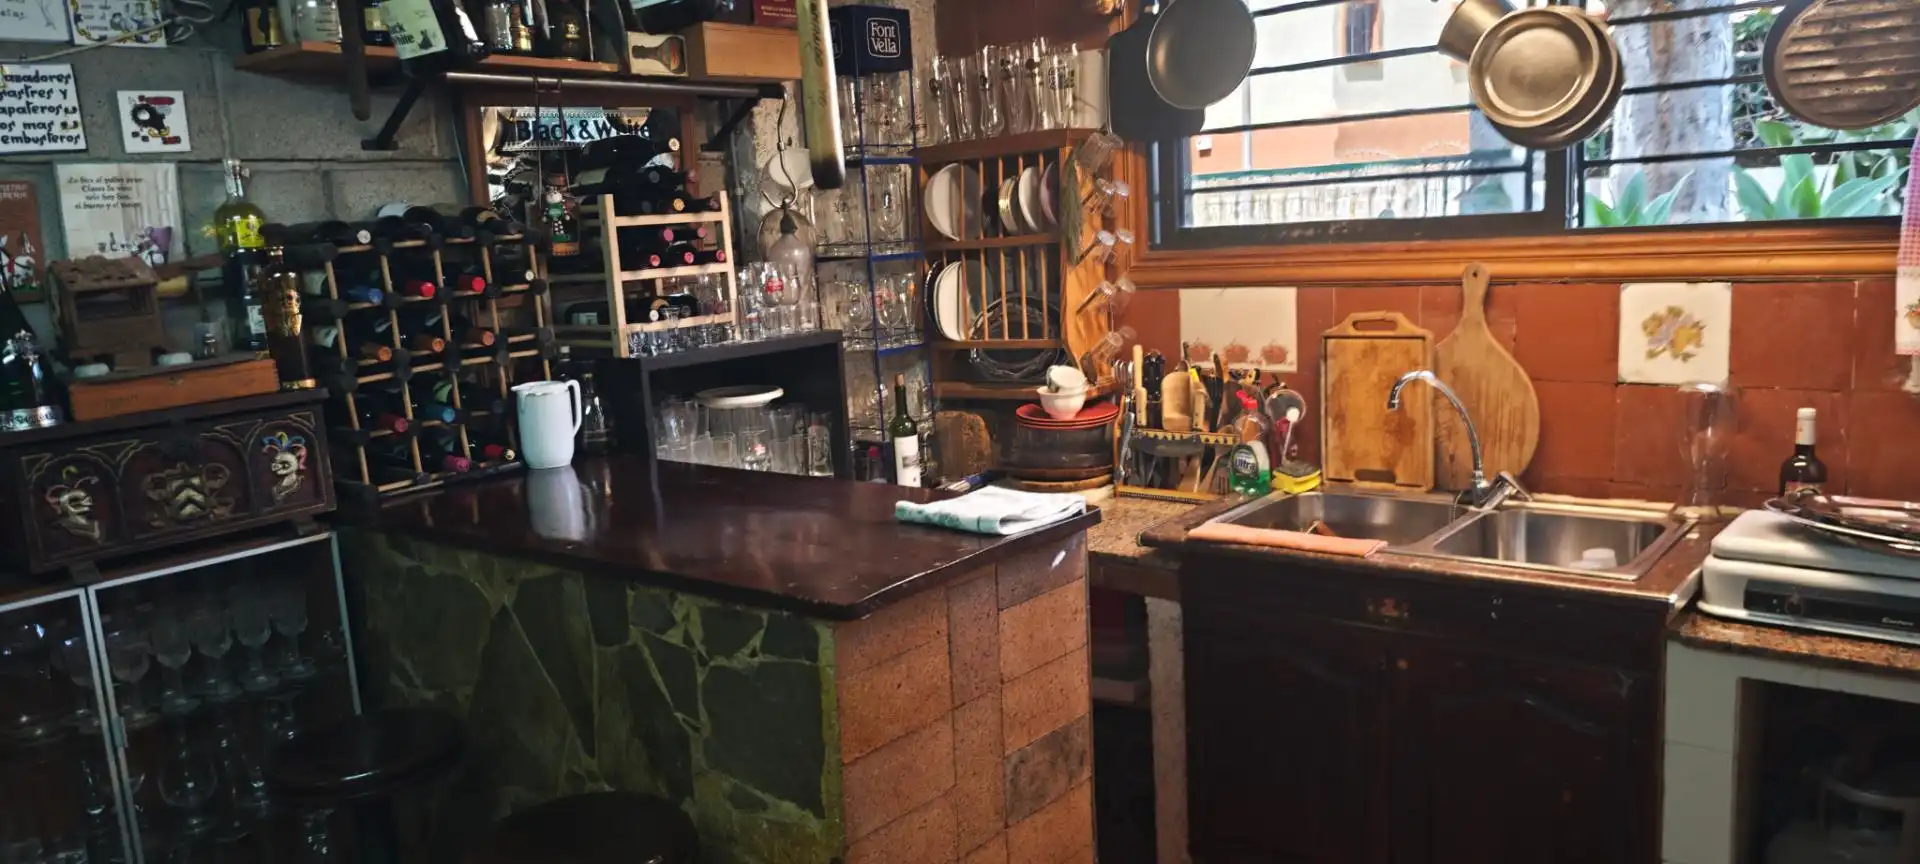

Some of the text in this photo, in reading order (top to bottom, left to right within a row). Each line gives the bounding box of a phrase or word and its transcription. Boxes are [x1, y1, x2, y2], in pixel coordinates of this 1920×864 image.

[871, 21, 895, 38] Font
[871, 37, 897, 53] Vella
[517, 120, 575, 140] Black
[578, 119, 594, 140] &
[1, 131, 80, 146] embusteros
